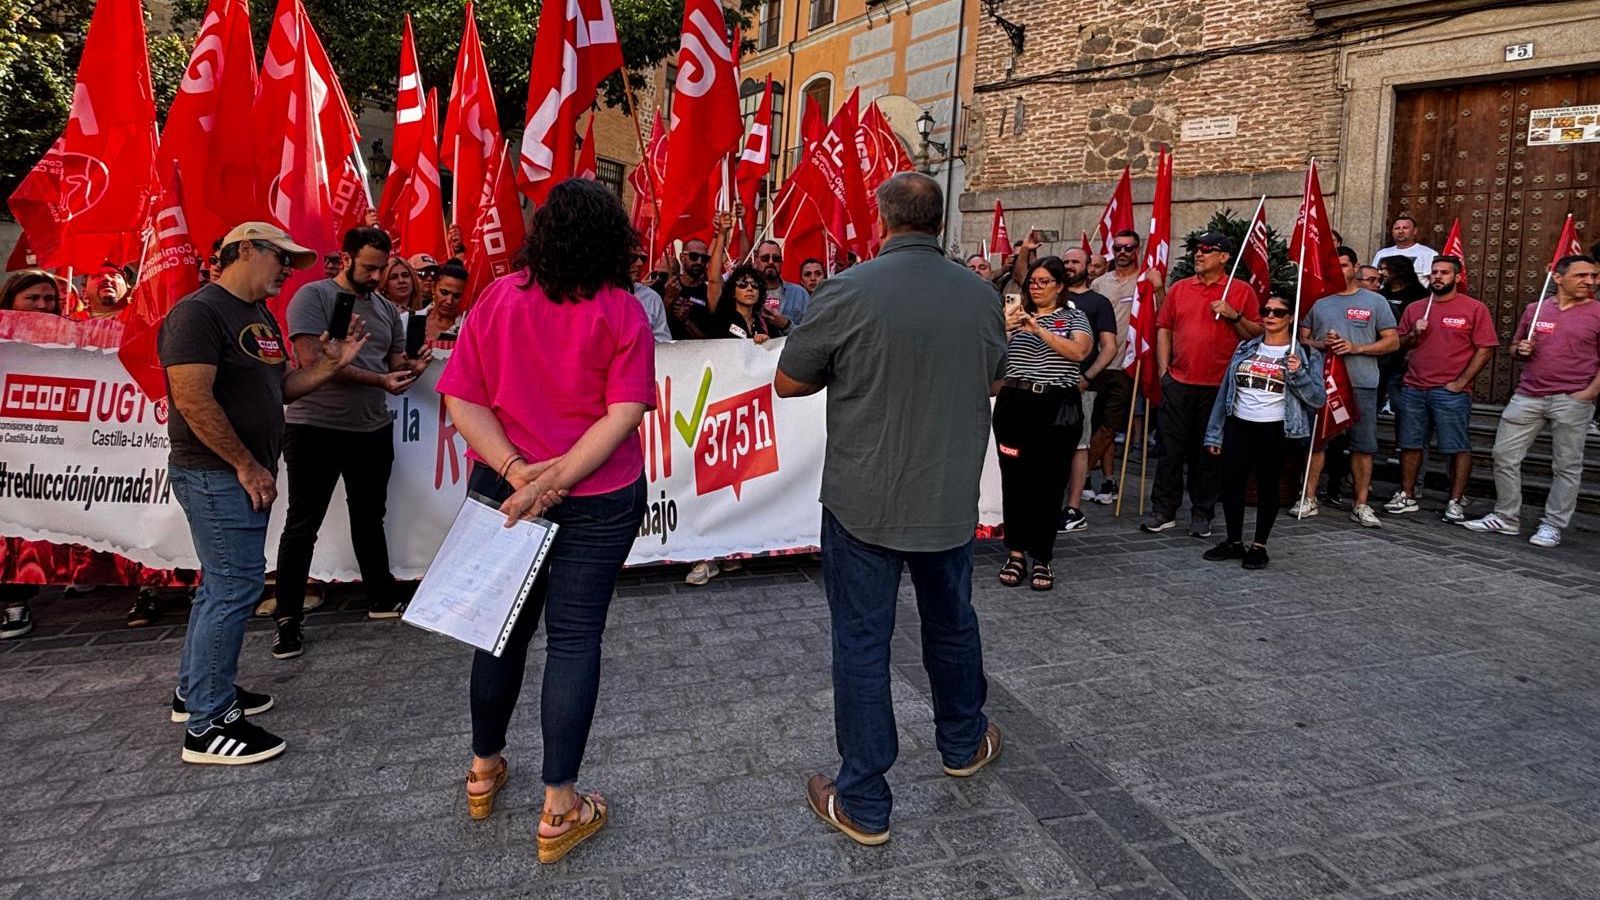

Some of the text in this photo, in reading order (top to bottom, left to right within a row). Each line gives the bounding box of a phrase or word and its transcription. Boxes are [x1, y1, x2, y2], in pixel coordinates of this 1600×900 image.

[1517, 45, 1528, 57] 5
[6, 383, 67, 412] CCOO
[97, 381, 147, 424] UGT
[402, 397, 420, 443] la
[39, 434, 65, 446] Mancha
[91, 428, 170, 449] Castilla-La Manc
[0, 461, 171, 511] #reducciónjornadaYA
